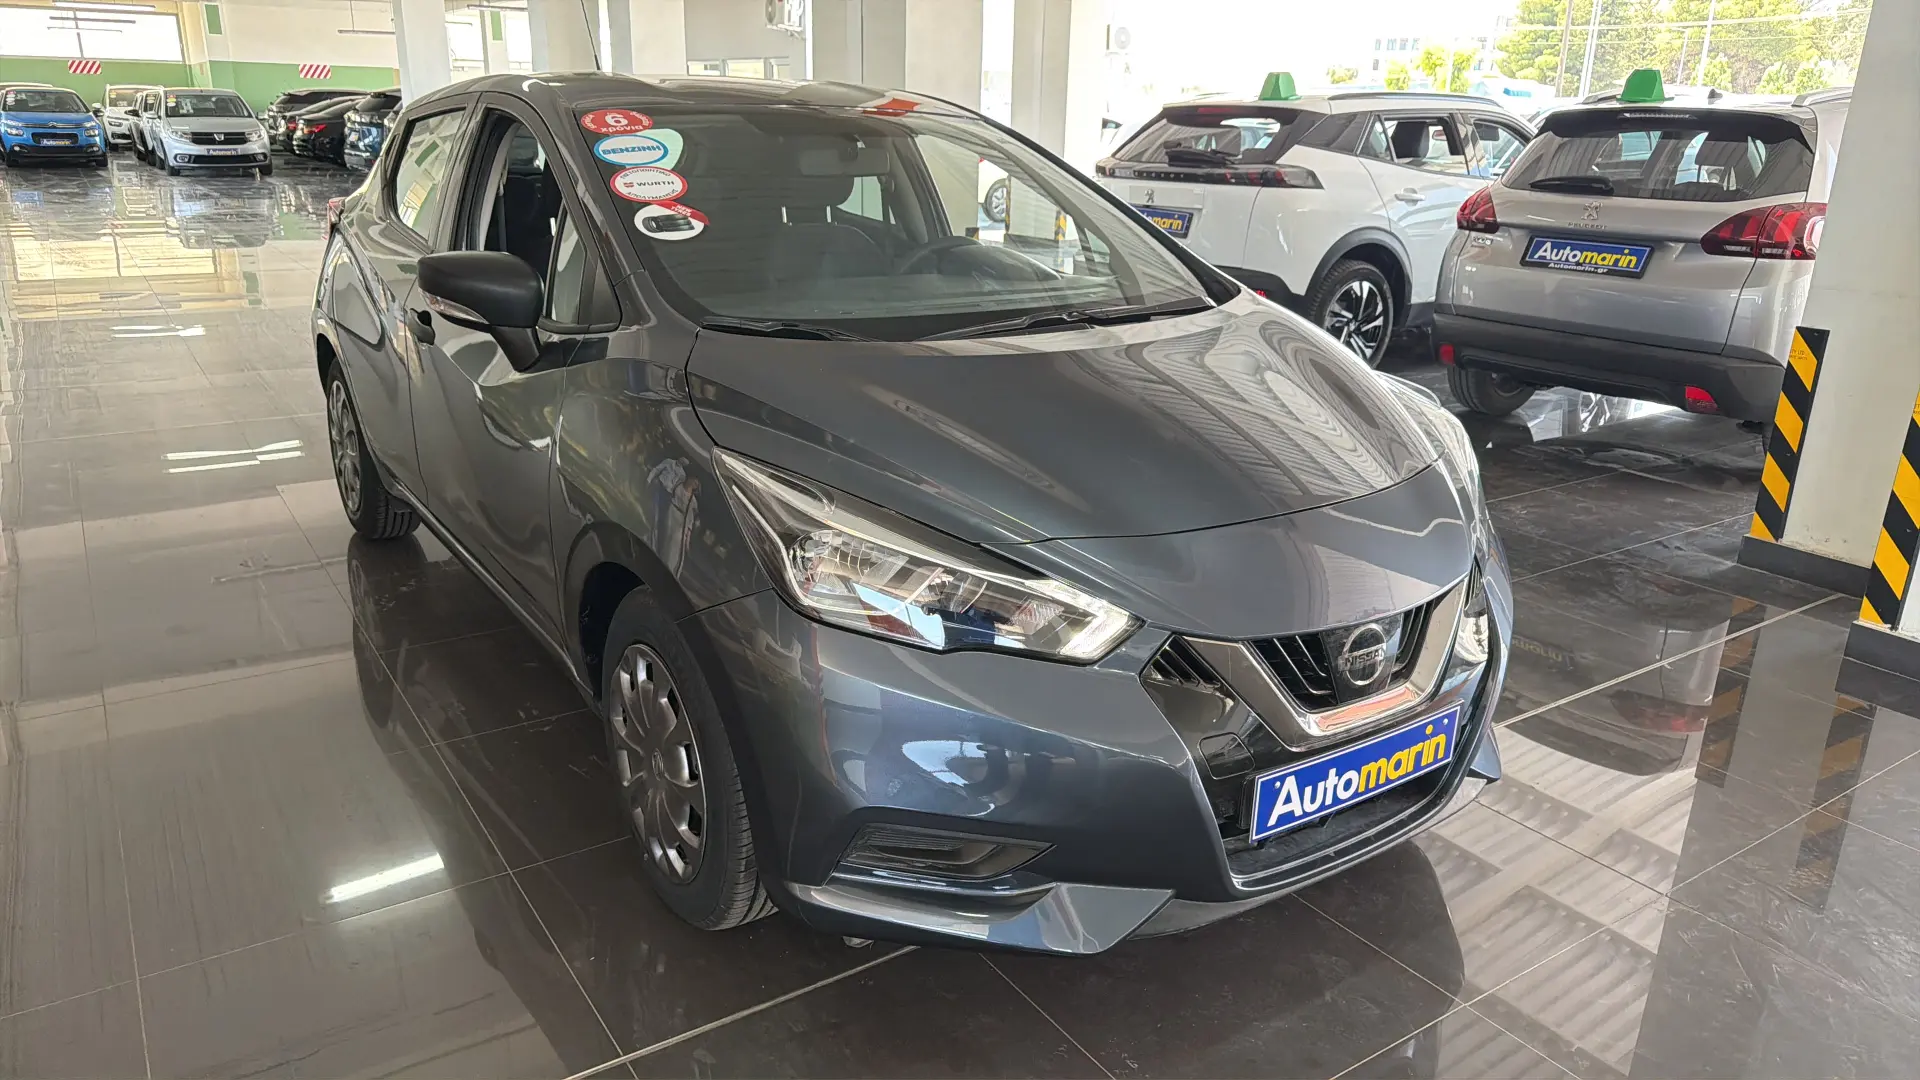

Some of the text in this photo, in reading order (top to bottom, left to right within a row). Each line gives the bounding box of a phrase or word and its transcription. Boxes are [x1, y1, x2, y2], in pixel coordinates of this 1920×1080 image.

[605, 114, 628, 126] 6
[1533, 241, 1637, 269] Automarin
[1548, 262, 1609, 274] Automarin.gr
[1266, 724, 1446, 828] Automarin
